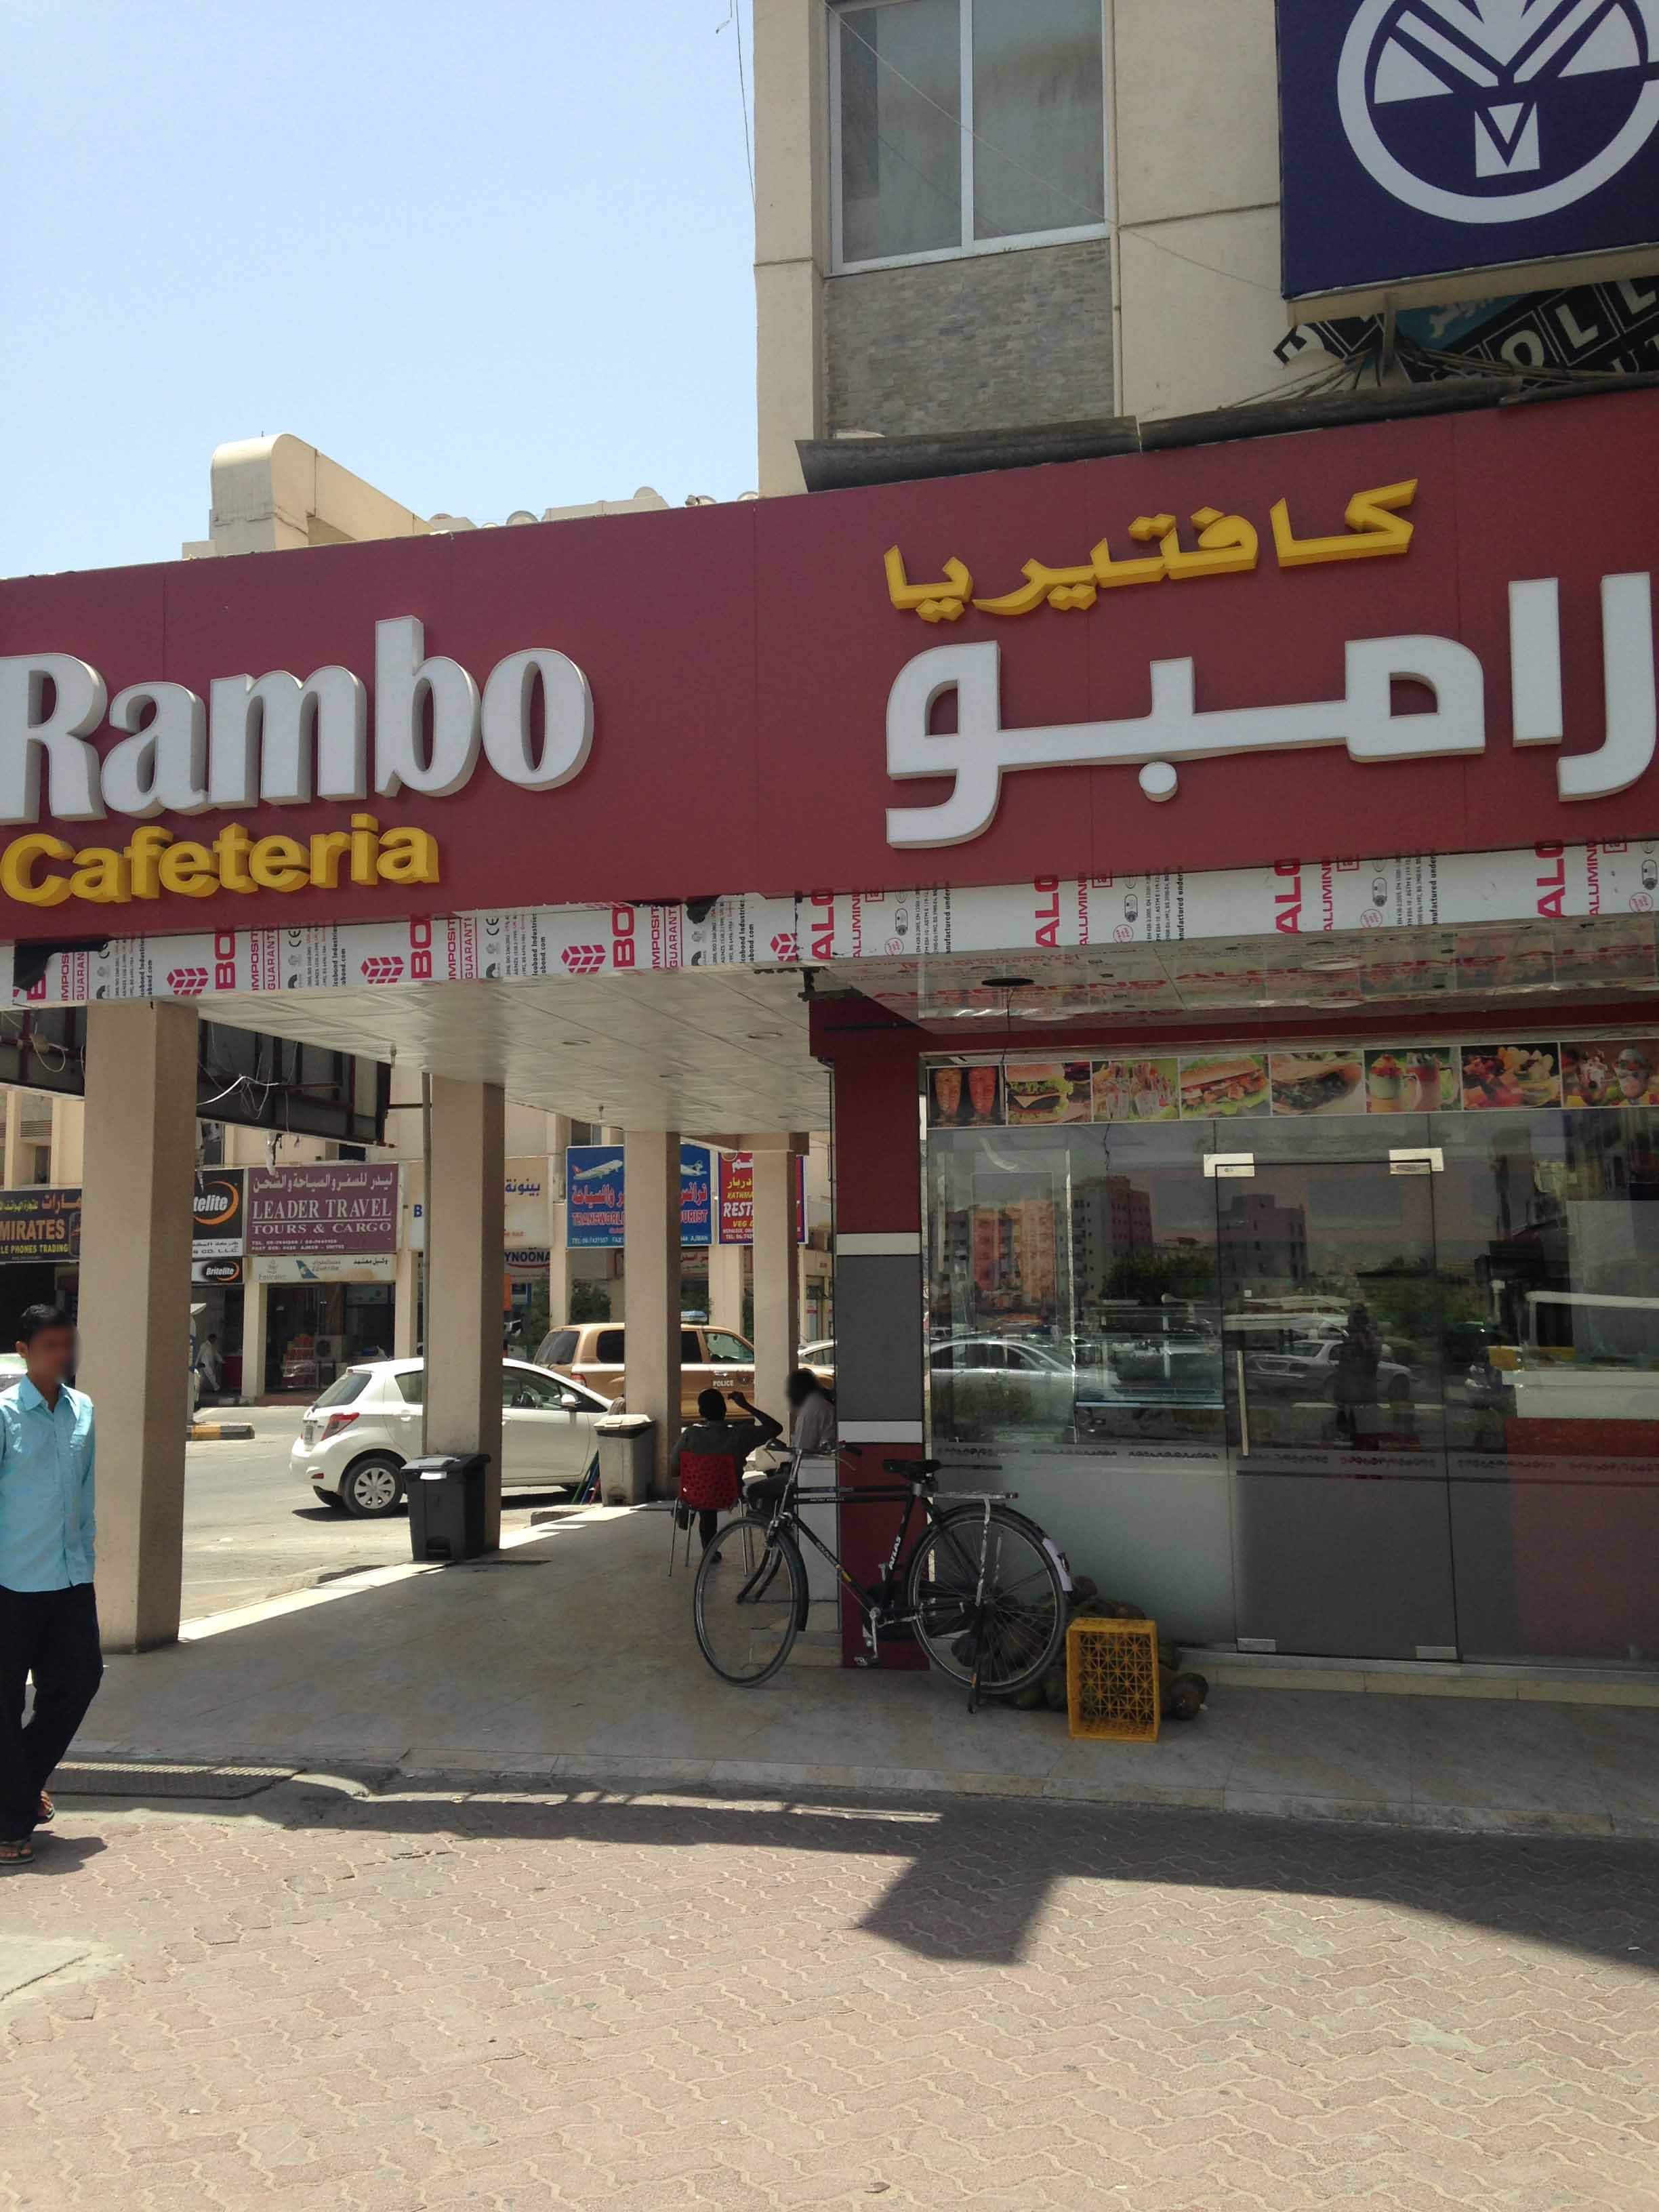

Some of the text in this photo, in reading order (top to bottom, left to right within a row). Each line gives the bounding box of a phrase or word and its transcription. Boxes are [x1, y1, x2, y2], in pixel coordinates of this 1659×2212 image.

[884, 478, 1418, 623] كافتيريا
[0, 615, 595, 825] Rambo
[886, 571, 1658, 849] رامبو
[0, 814, 441, 907] Cafeteria
[11, 1244, 37, 1254] PHONES
[39, 1244, 69, 1253] TRADING
[253, 1198, 391, 1219] LEADER TRAVEL
[253, 1223, 391, 1235] TOURS & CARGO
